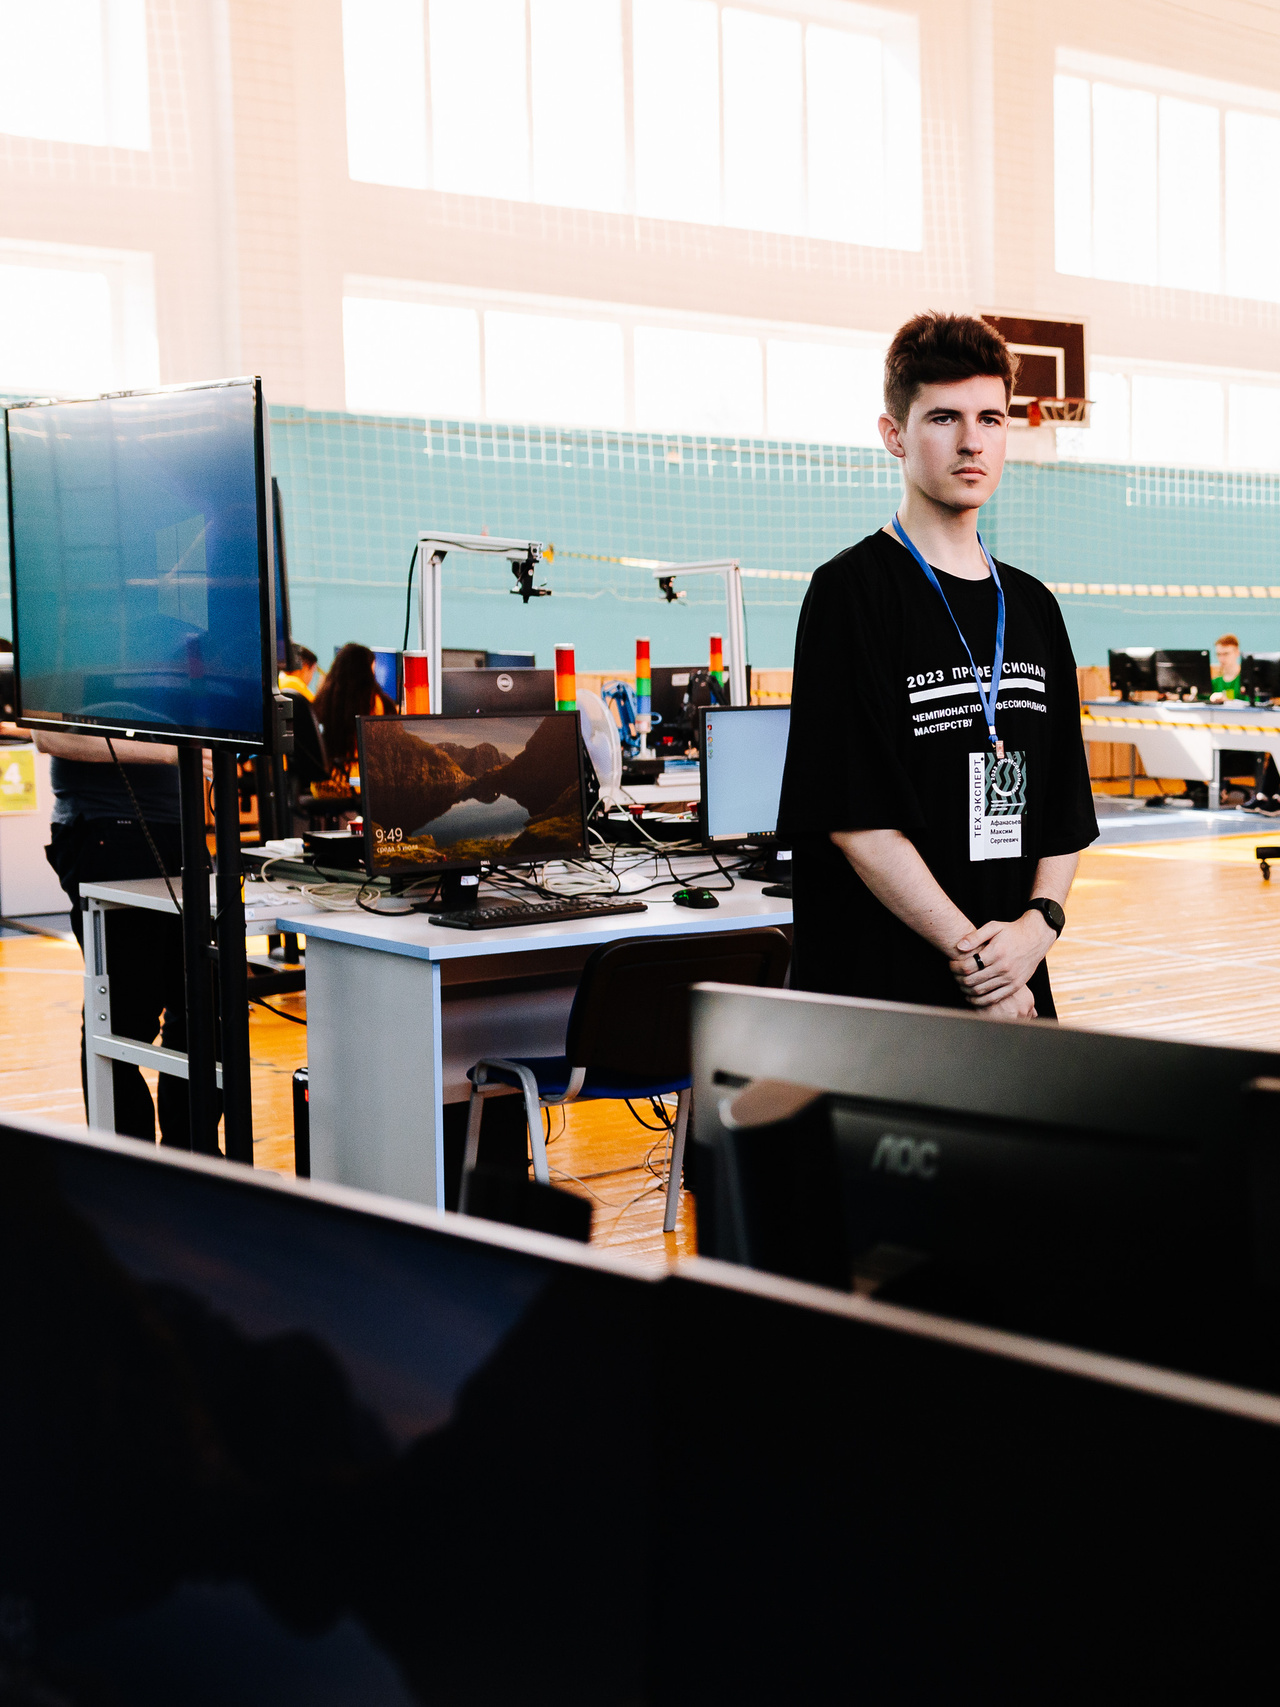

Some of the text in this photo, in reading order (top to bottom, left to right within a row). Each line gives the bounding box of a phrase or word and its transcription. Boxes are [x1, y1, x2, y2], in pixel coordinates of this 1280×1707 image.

[906, 670, 945, 688] 2023
[912, 705, 970, 723] ЧЕМПИОНАТ
[969, 703, 983, 714] ПО
[913, 718, 973, 737] МАСТЕРСТВУ
[375, 827, 403, 844] 9:49
